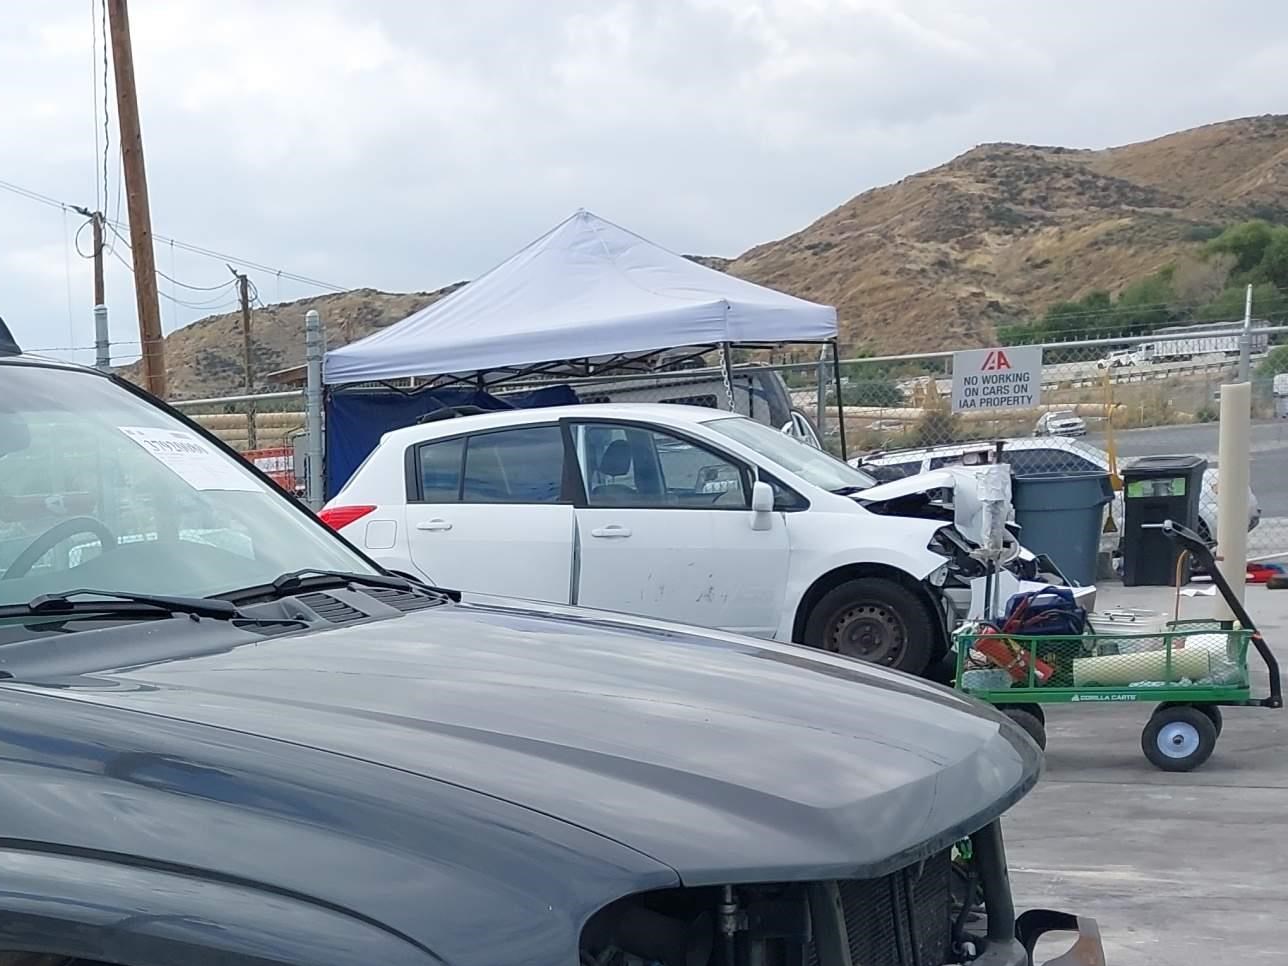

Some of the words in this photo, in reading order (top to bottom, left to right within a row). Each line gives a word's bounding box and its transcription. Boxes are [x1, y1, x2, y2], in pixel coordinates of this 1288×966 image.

[963, 376, 978, 386] NO
[981, 372, 1030, 385] WORKING
[964, 387, 979, 397] ON
[982, 385, 1010, 396] CARS
[1013, 384, 1028, 394] ON
[959, 399, 976, 409] IAA
[979, 395, 1033, 408] PROPERTY
